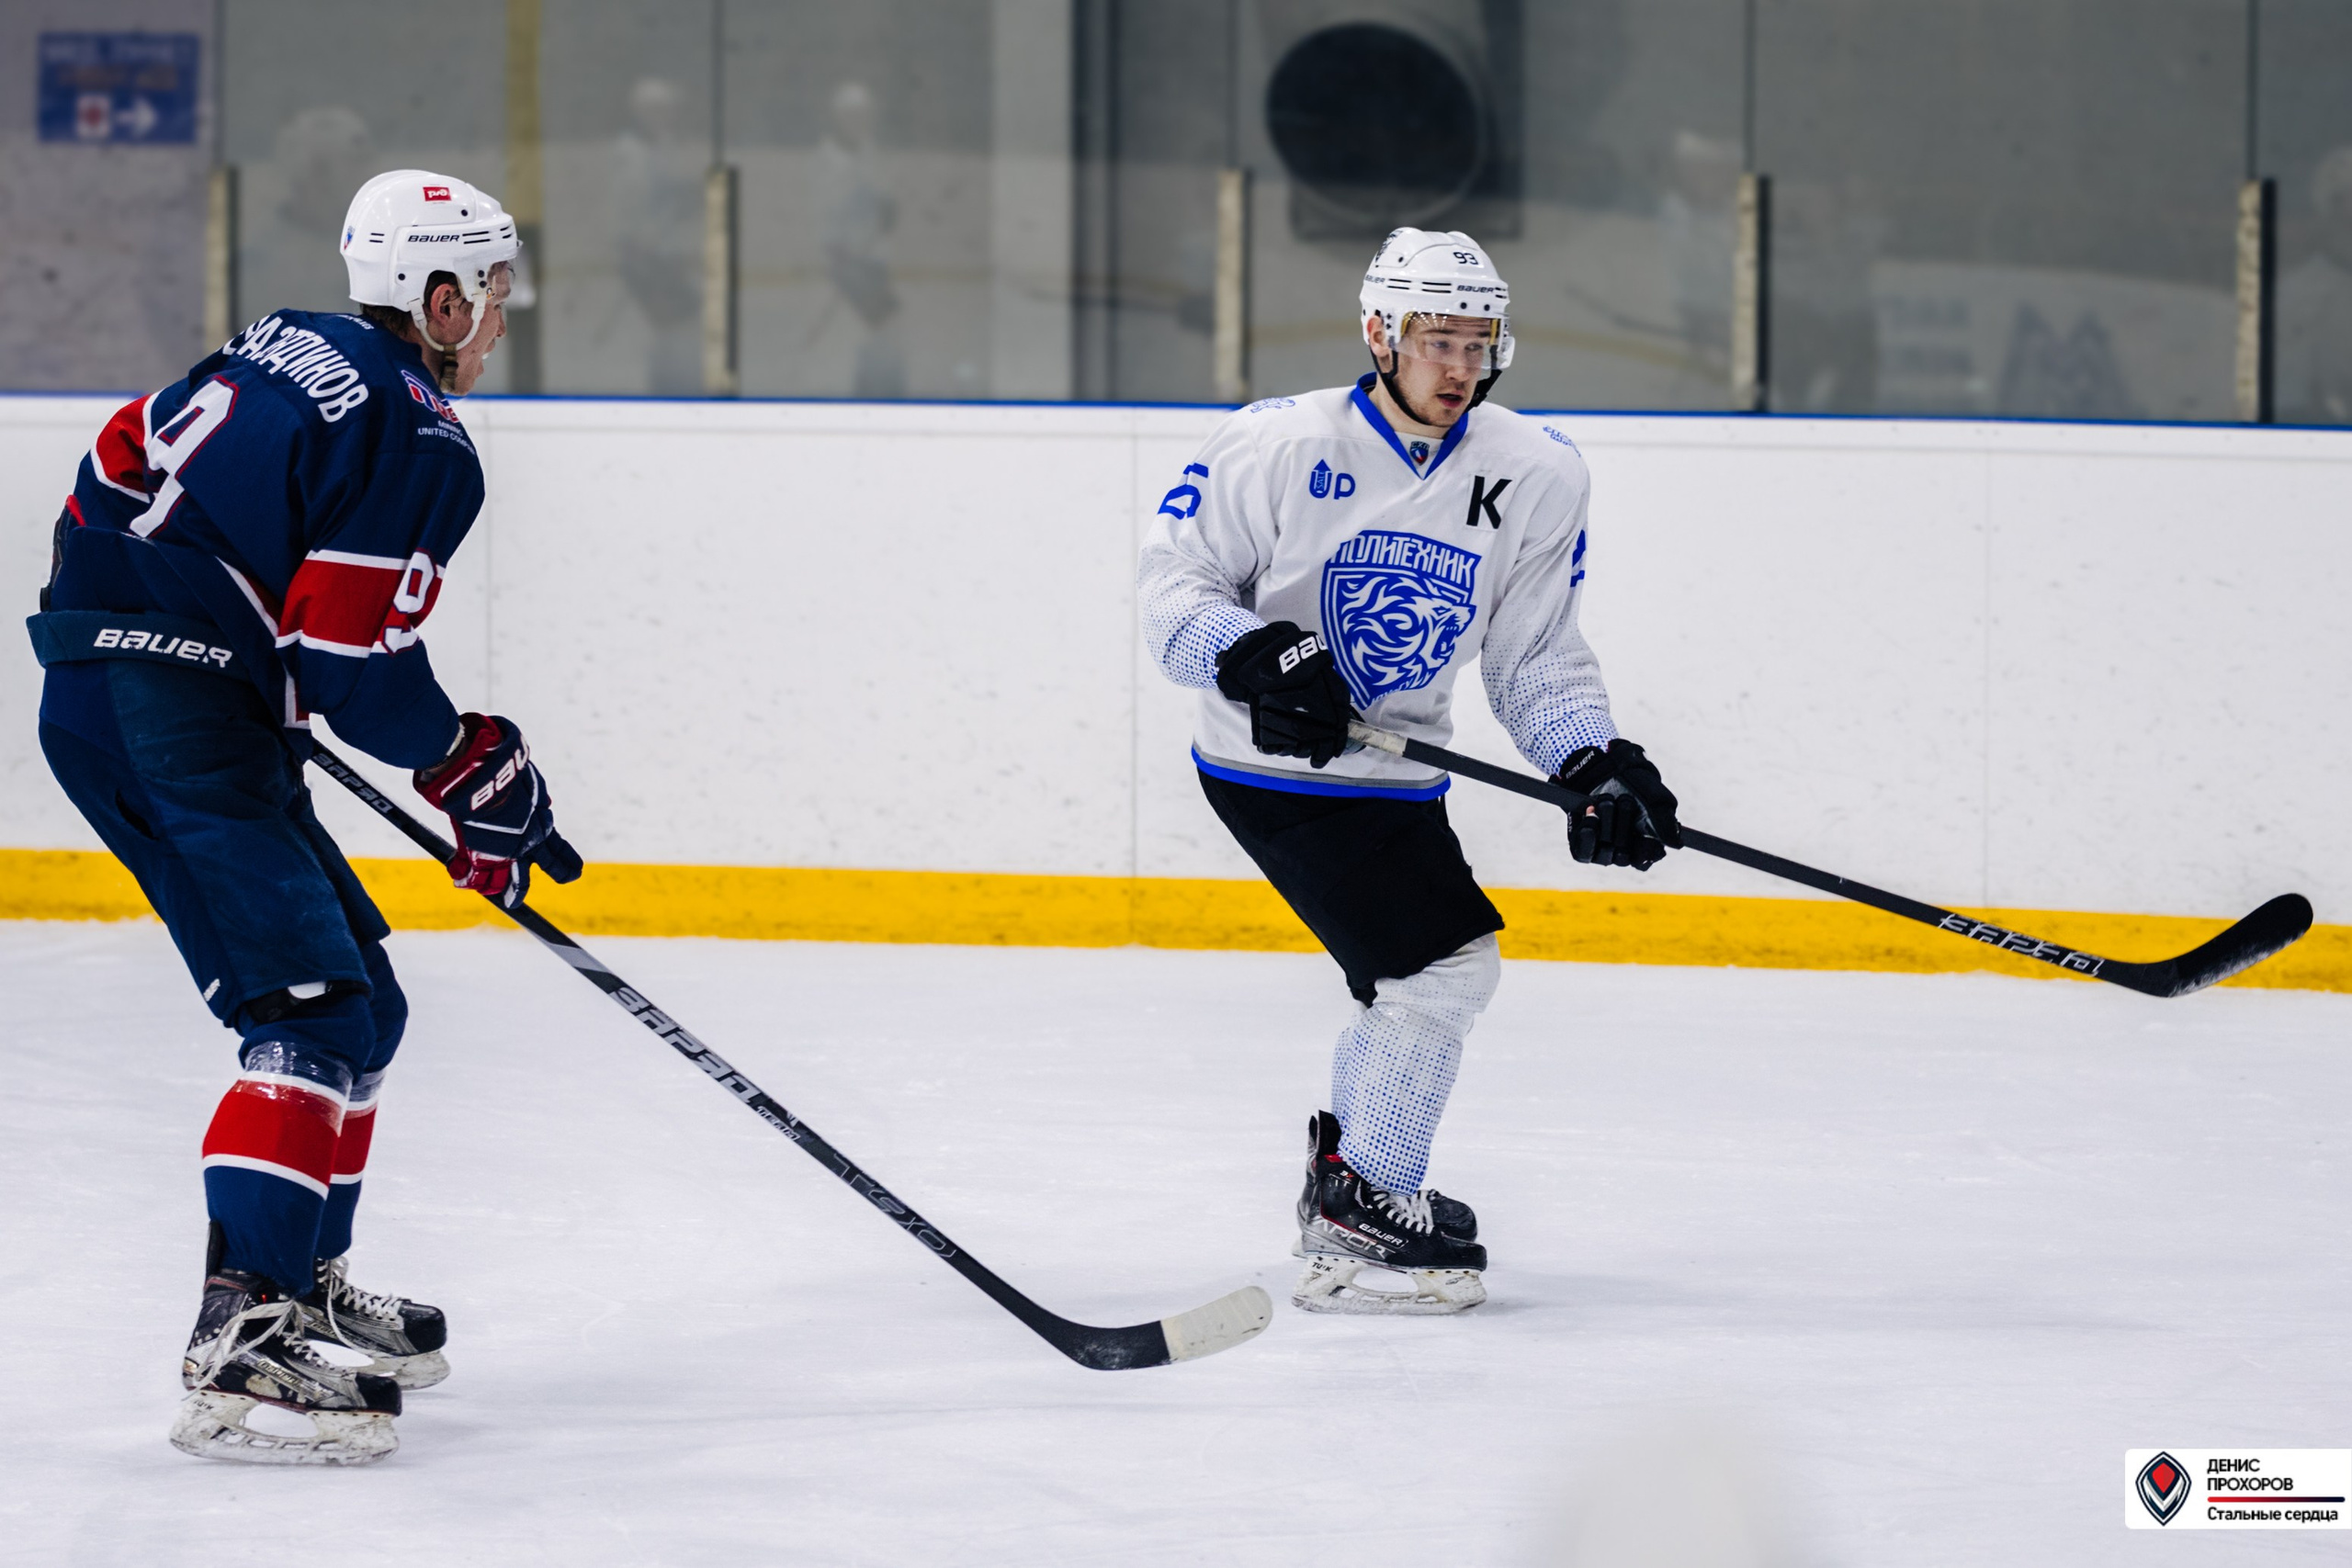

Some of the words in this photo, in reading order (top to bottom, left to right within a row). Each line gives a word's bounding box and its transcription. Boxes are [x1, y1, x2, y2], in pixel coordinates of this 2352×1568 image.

[407, 234, 460, 243] BAUER
[1453, 252, 1479, 265] 93
[1456, 285, 1496, 294] BAUER
[94, 628, 233, 668] BAUER
[1566, 750, 1595, 779] BAUER
[1359, 1223, 1403, 1247] BAUER
